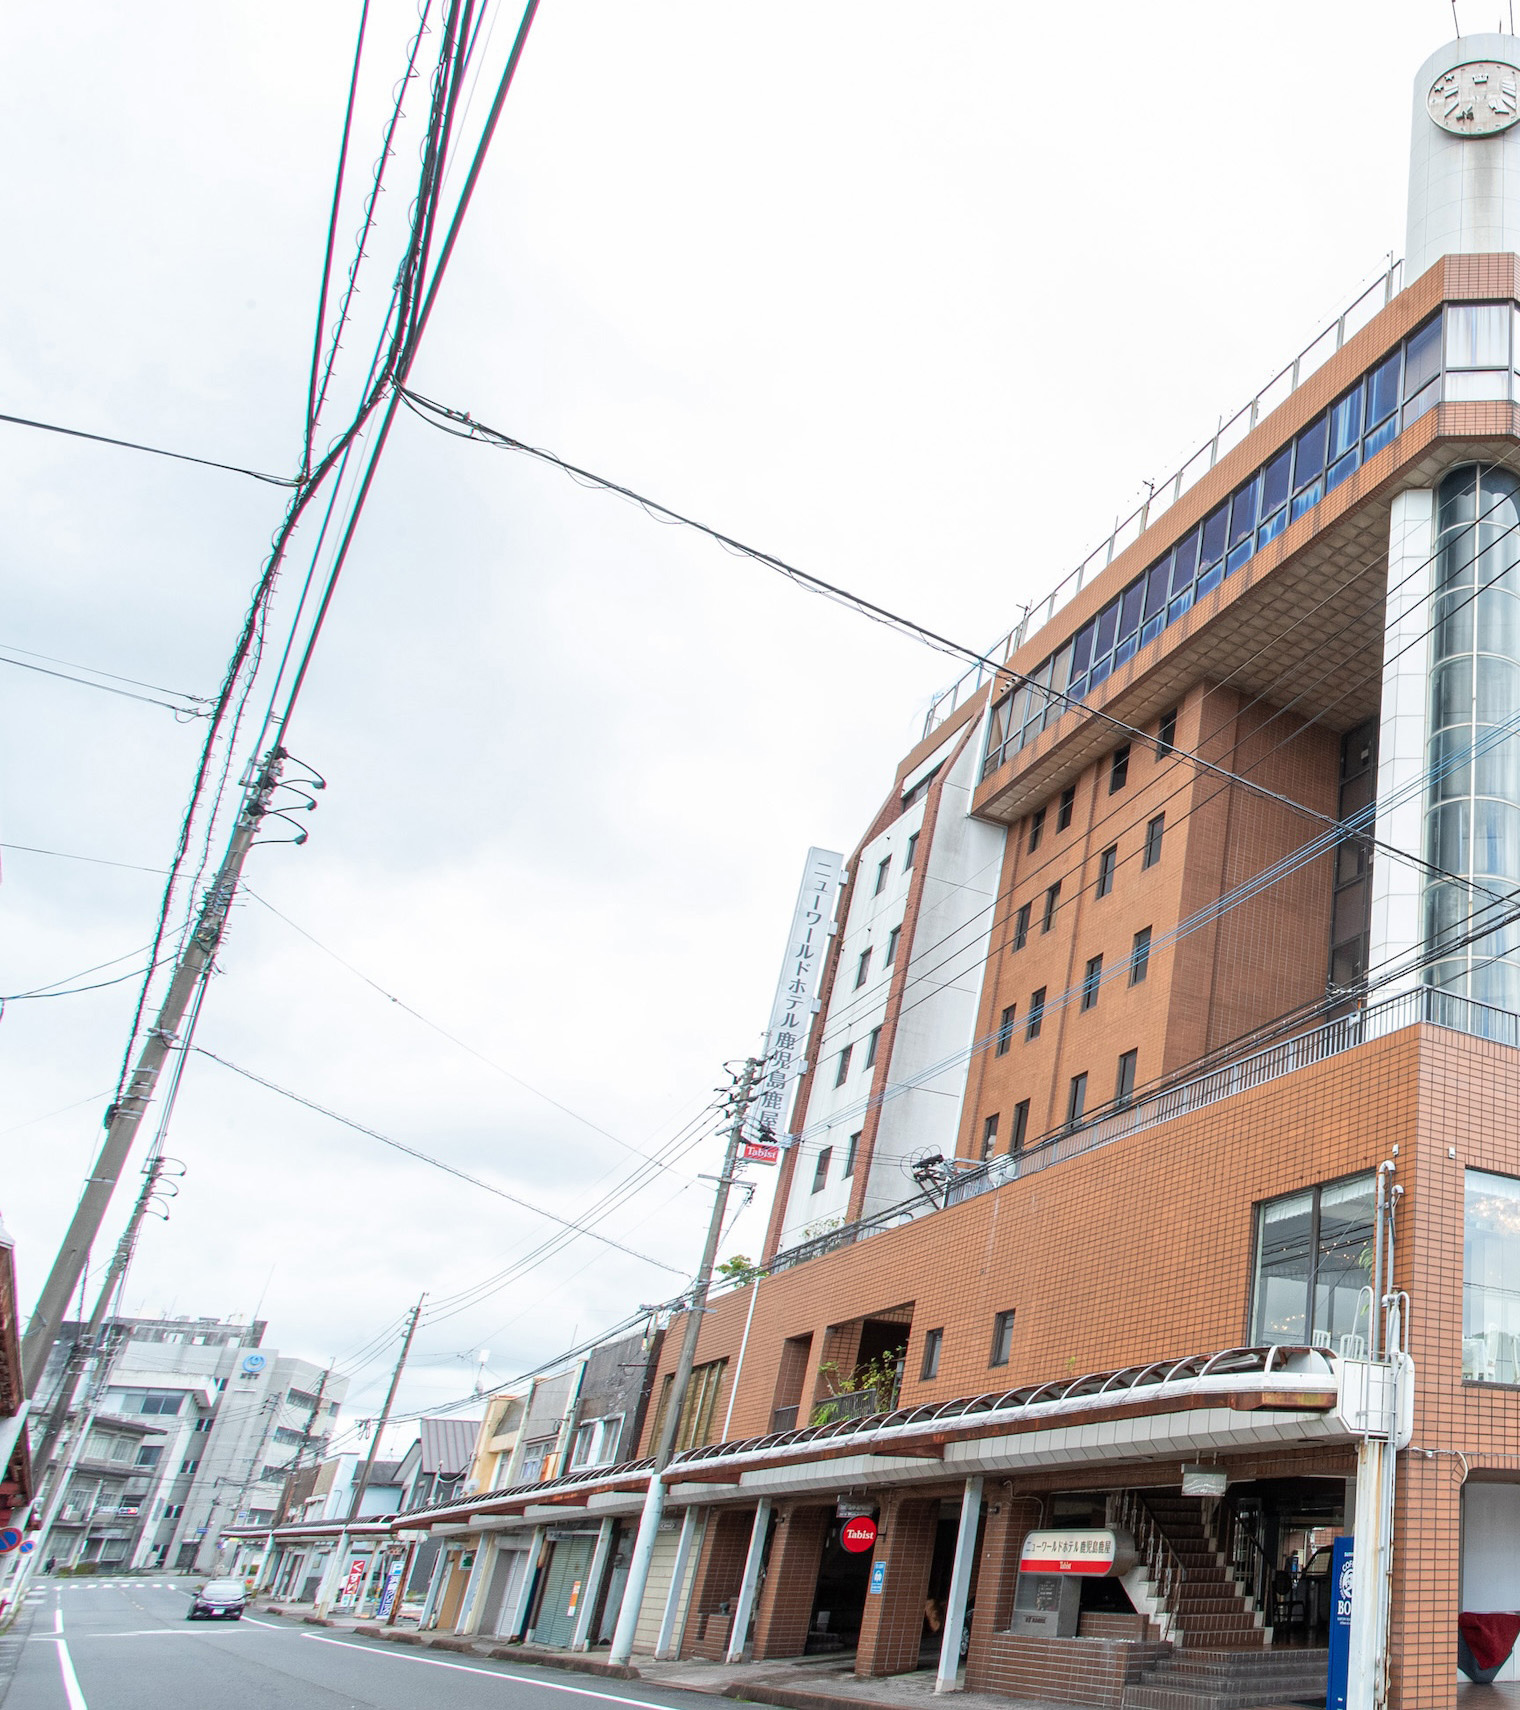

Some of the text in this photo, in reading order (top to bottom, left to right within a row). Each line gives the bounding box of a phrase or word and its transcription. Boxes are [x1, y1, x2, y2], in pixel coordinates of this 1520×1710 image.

[747, 1146, 777, 1159] Tabist
[846, 1529, 874, 1540] Tabist
[1025, 1540, 1112, 1554] ニューワールドホテル鹿児島鹿屋
[1338, 1600, 1351, 1615] BO
